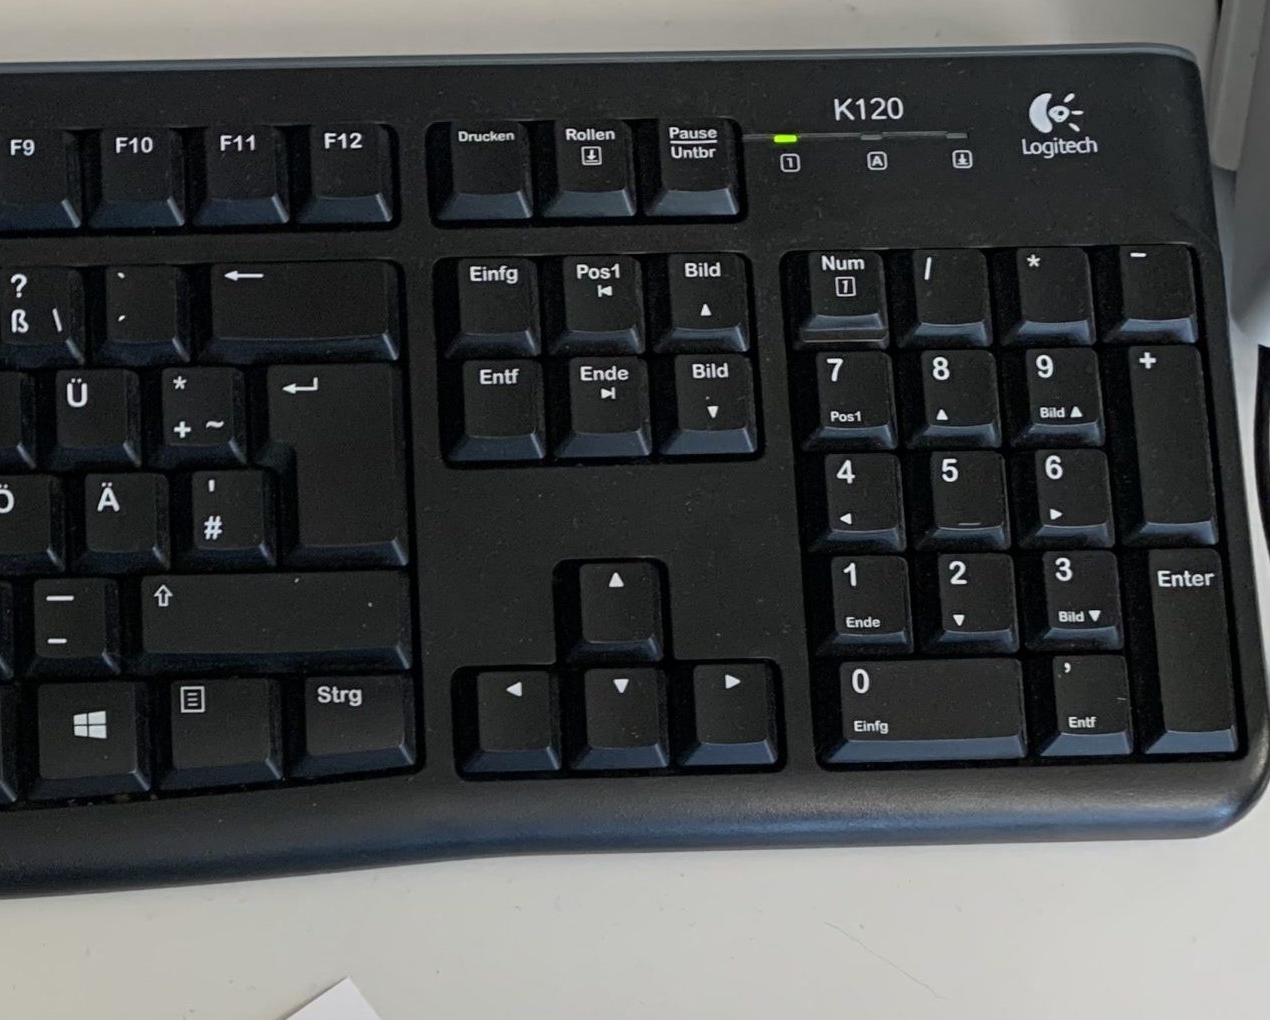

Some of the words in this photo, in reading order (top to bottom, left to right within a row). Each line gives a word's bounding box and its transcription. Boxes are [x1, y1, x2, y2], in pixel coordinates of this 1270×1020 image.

[833, 96, 904, 121] K120
[324, 132, 363, 150] F12
[458, 130, 515, 143] Drucken
[565, 128, 616, 141] Rollen
[668, 126, 718, 139] Pause
[10, 139, 36, 157] F9
[115, 136, 154, 154] F10
[219, 134, 256, 152] F11
[1021, 136, 1099, 159] Logitech
[670, 146, 717, 159] Untbr
[576, 263, 621, 280] Pos1
[684, 261, 722, 278] Bild
[821, 255, 865, 271] Num
[469, 265, 519, 285] Einfg
[11, 308, 30, 334] ß
[579, 365, 629, 382] Ende
[691, 362, 729, 379] Bild
[826, 357, 844, 382] 7
[932, 356, 950, 381] 8
[1035, 354, 1054, 379] 9
[479, 368, 520, 385] Entf
[66, 377, 88, 408] Ü
[829, 410, 863, 423] Pos1
[1039, 406, 1066, 419] Bild
[836, 459, 856, 485] 4
[941, 458, 959, 483] 5
[1044, 454, 1064, 480] 6
[97, 481, 120, 512] Ä
[843, 562, 857, 587] 1
[948, 560, 968, 585] 2
[1055, 557, 1073, 582] 3
[1157, 570, 1215, 588] Enter
[845, 616, 881, 628] Ende
[1058, 610, 1085, 623] Bild
[851, 668, 870, 694] 0
[317, 685, 363, 707] Strg
[853, 719, 889, 735] Einfg
[1068, 716, 1097, 729] Entf
